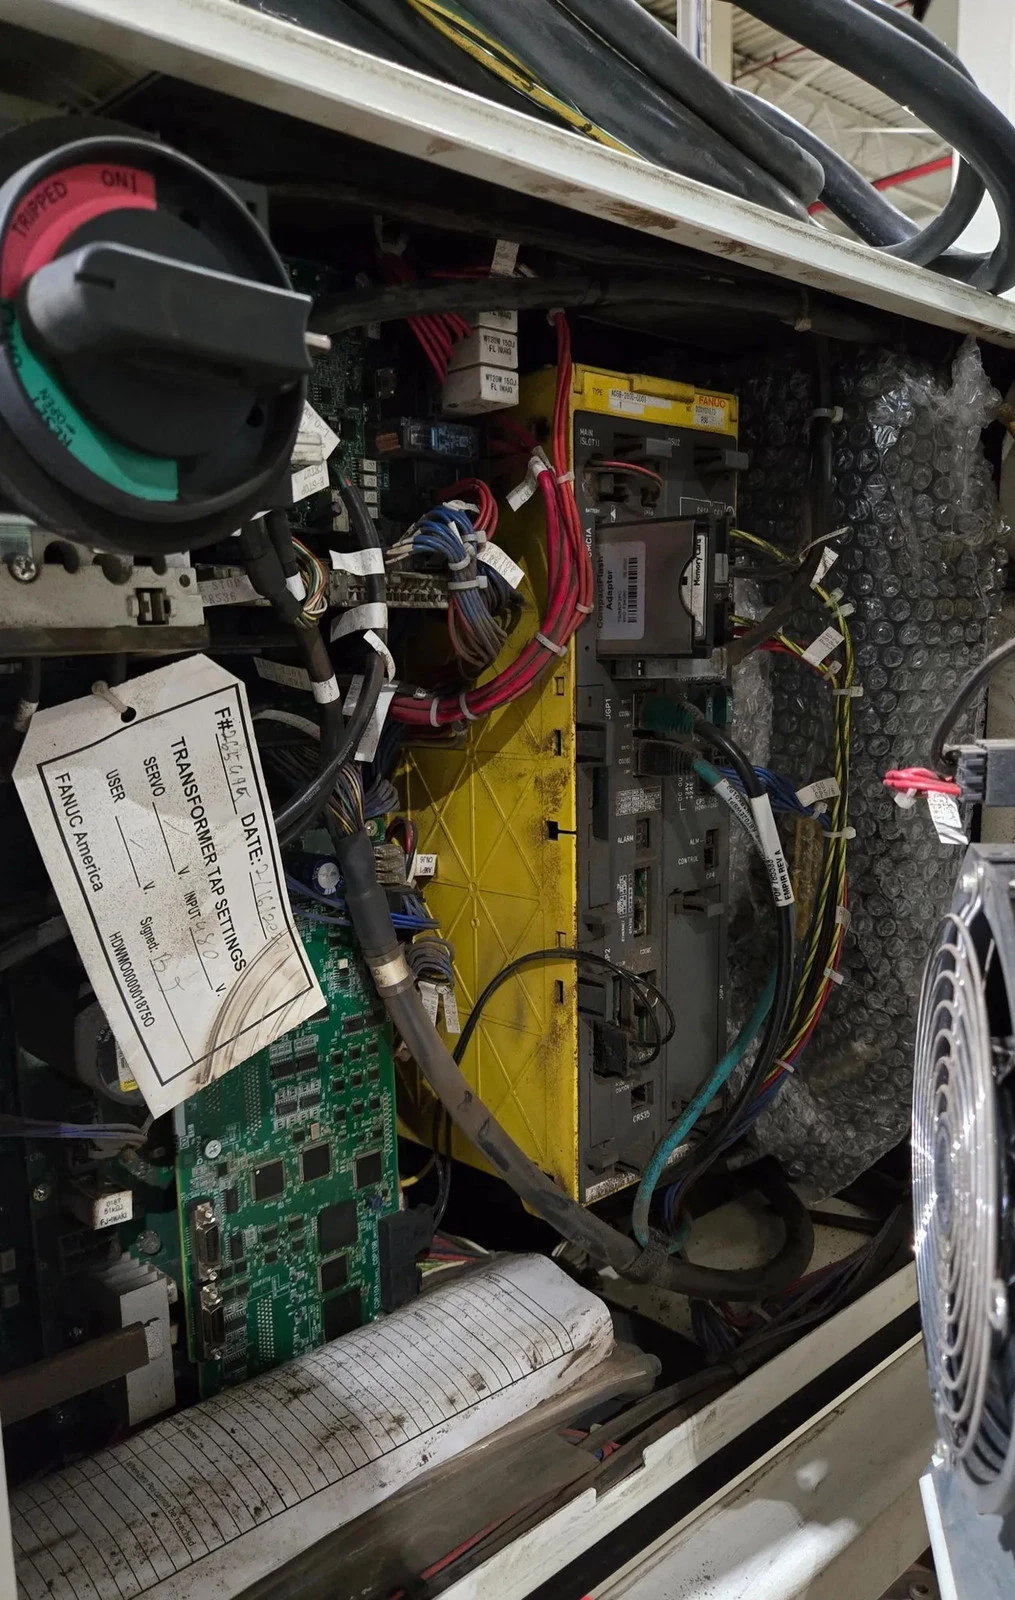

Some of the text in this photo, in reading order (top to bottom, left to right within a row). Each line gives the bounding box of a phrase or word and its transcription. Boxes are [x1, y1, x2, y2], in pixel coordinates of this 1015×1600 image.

[11, 180, 68, 238] TRIPPED
[592, 387, 603, 396] TYPE
[698, 396, 726, 409] FANUC
[579, 428, 594, 436] MAIN
[693, 556, 703, 586] Memory
[214, 706, 233, 730] F#
[105, 769, 126, 803] USER
[143, 756, 166, 798] SERVO
[55, 771, 104, 893] FANUC America
[240, 812, 263, 866] DATE:
[617, 835, 634, 843] ALARM
[171, 736, 247, 972] TRANSFORMER TAP SETTINGS
[678, 856, 699, 865] CONTROL
[776, 858, 786, 874] REV
[780, 875, 792, 901] EMPIR
[183, 890, 201, 921] INPUT
[139, 915, 161, 954] Signed:
[153, 1491, 172, 1510] cannot
[168, 1505, 178, 1518] be
[175, 1518, 196, 1547] reached
